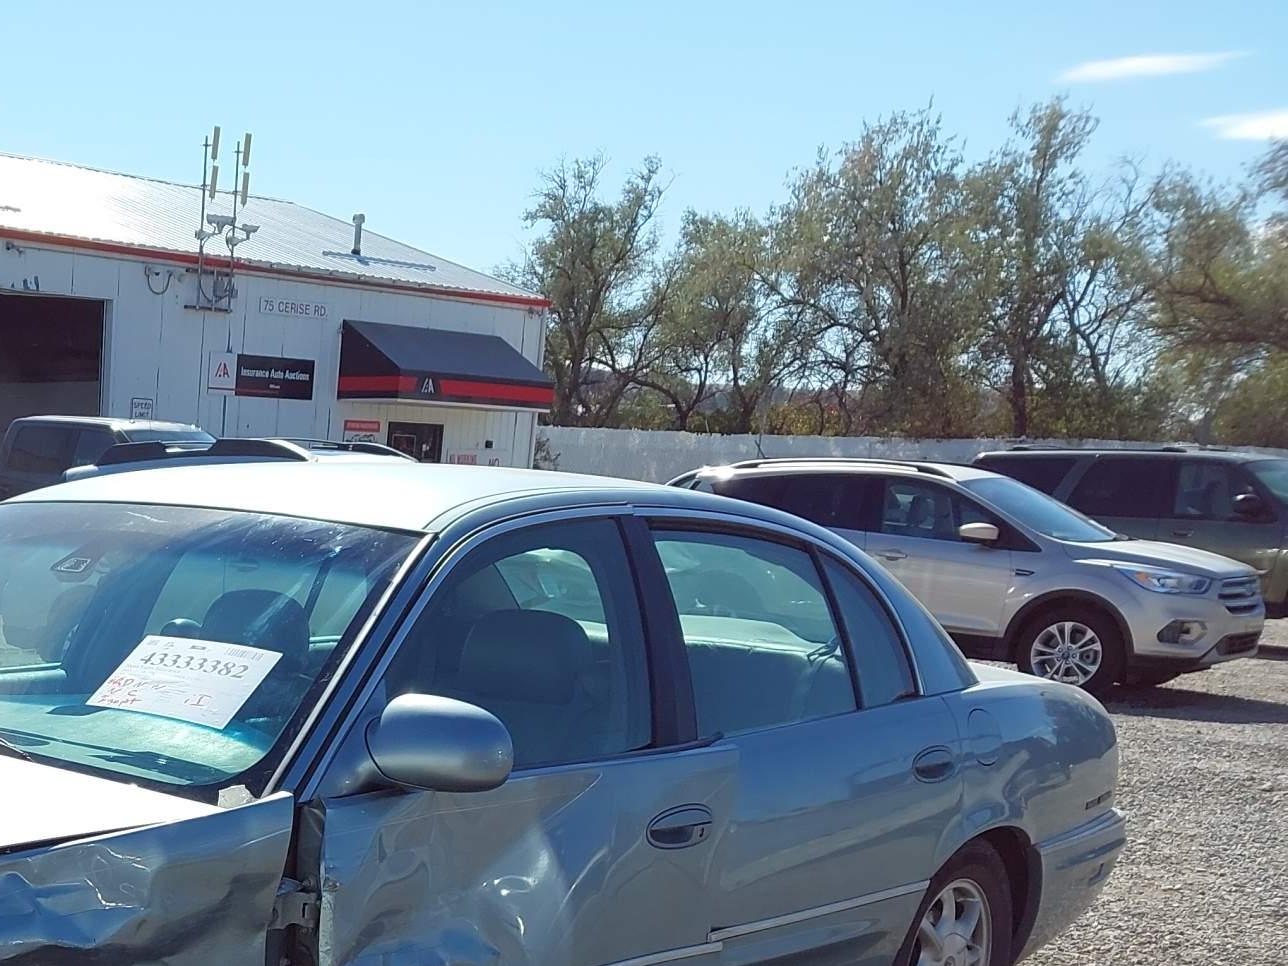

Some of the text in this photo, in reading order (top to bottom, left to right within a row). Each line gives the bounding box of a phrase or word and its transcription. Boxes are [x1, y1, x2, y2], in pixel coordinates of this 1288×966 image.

[278, 301, 311, 315] CERISE
[240, 366, 310, 381] Insurance Auto Auctions
[133, 401, 152, 409] SPEED
[140, 652, 249, 679] 43333382
